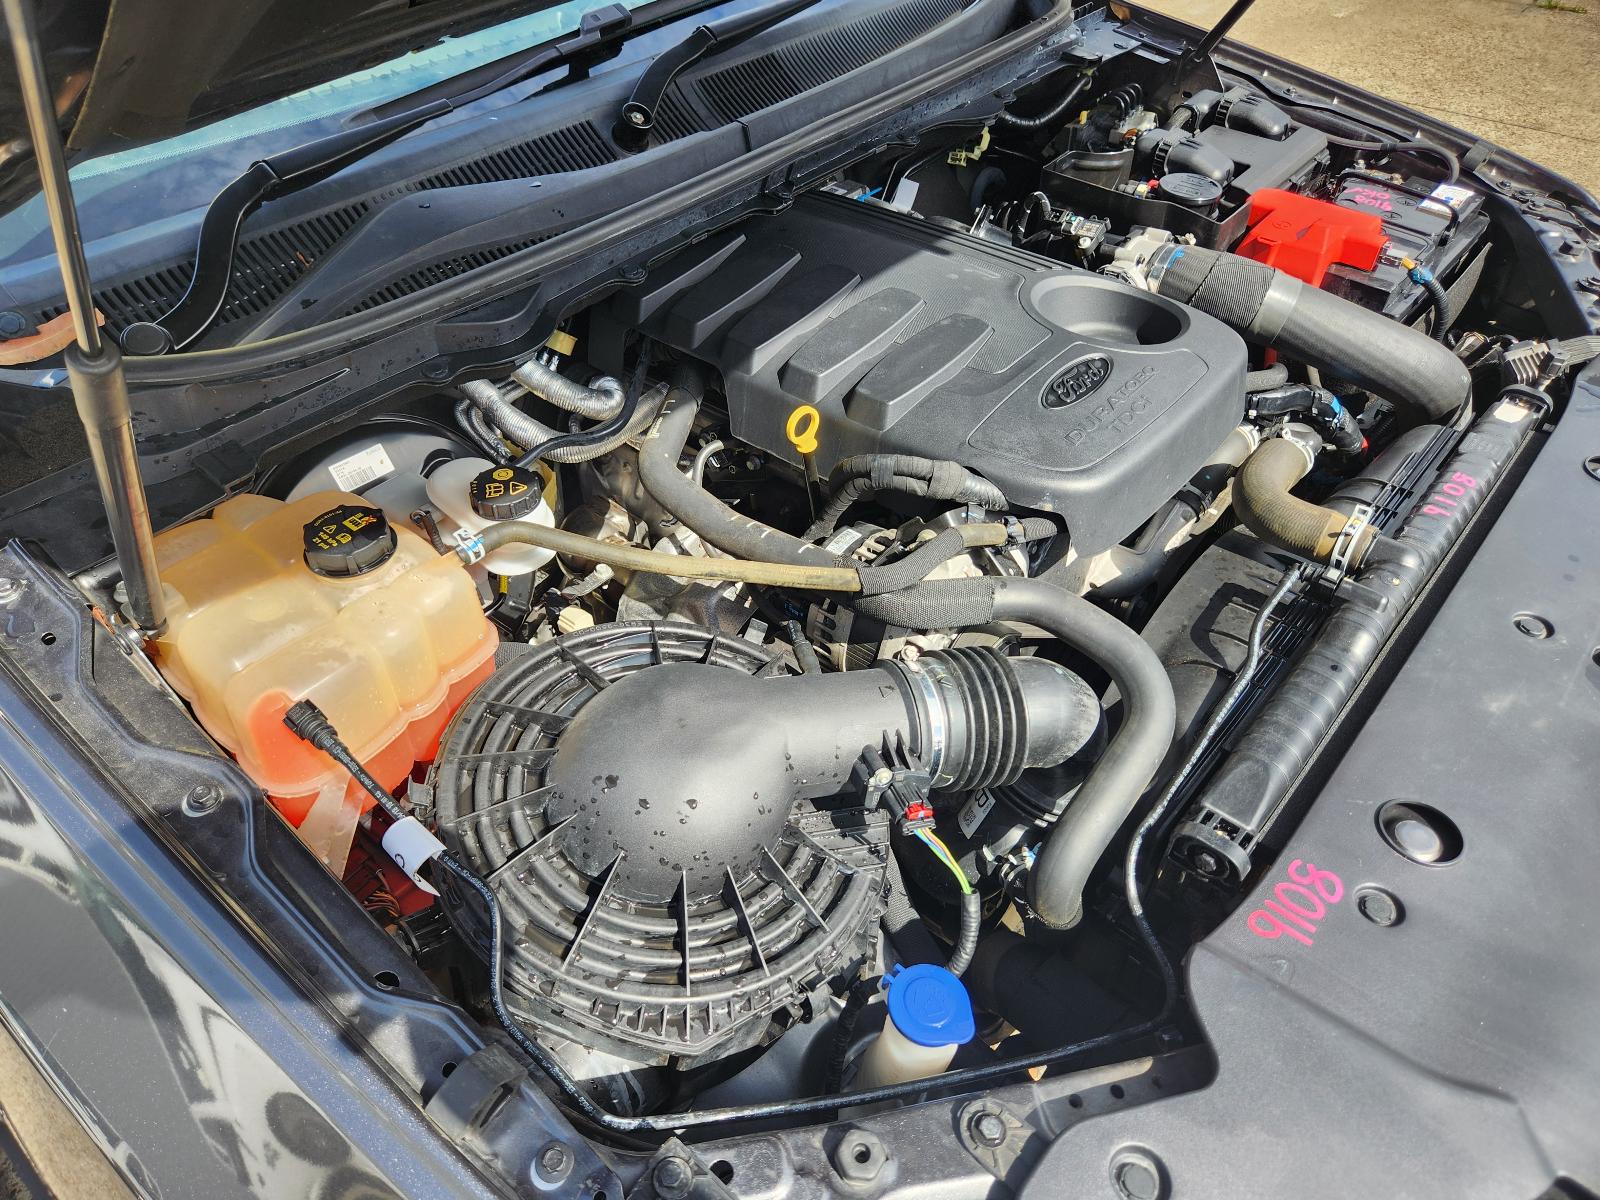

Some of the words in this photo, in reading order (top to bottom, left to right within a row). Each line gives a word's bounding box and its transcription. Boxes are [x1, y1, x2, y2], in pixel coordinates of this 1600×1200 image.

[1052, 361, 1104, 403] Ford
[1423, 470, 1478, 517] 9108
[1246, 858, 1345, 948] 9108
